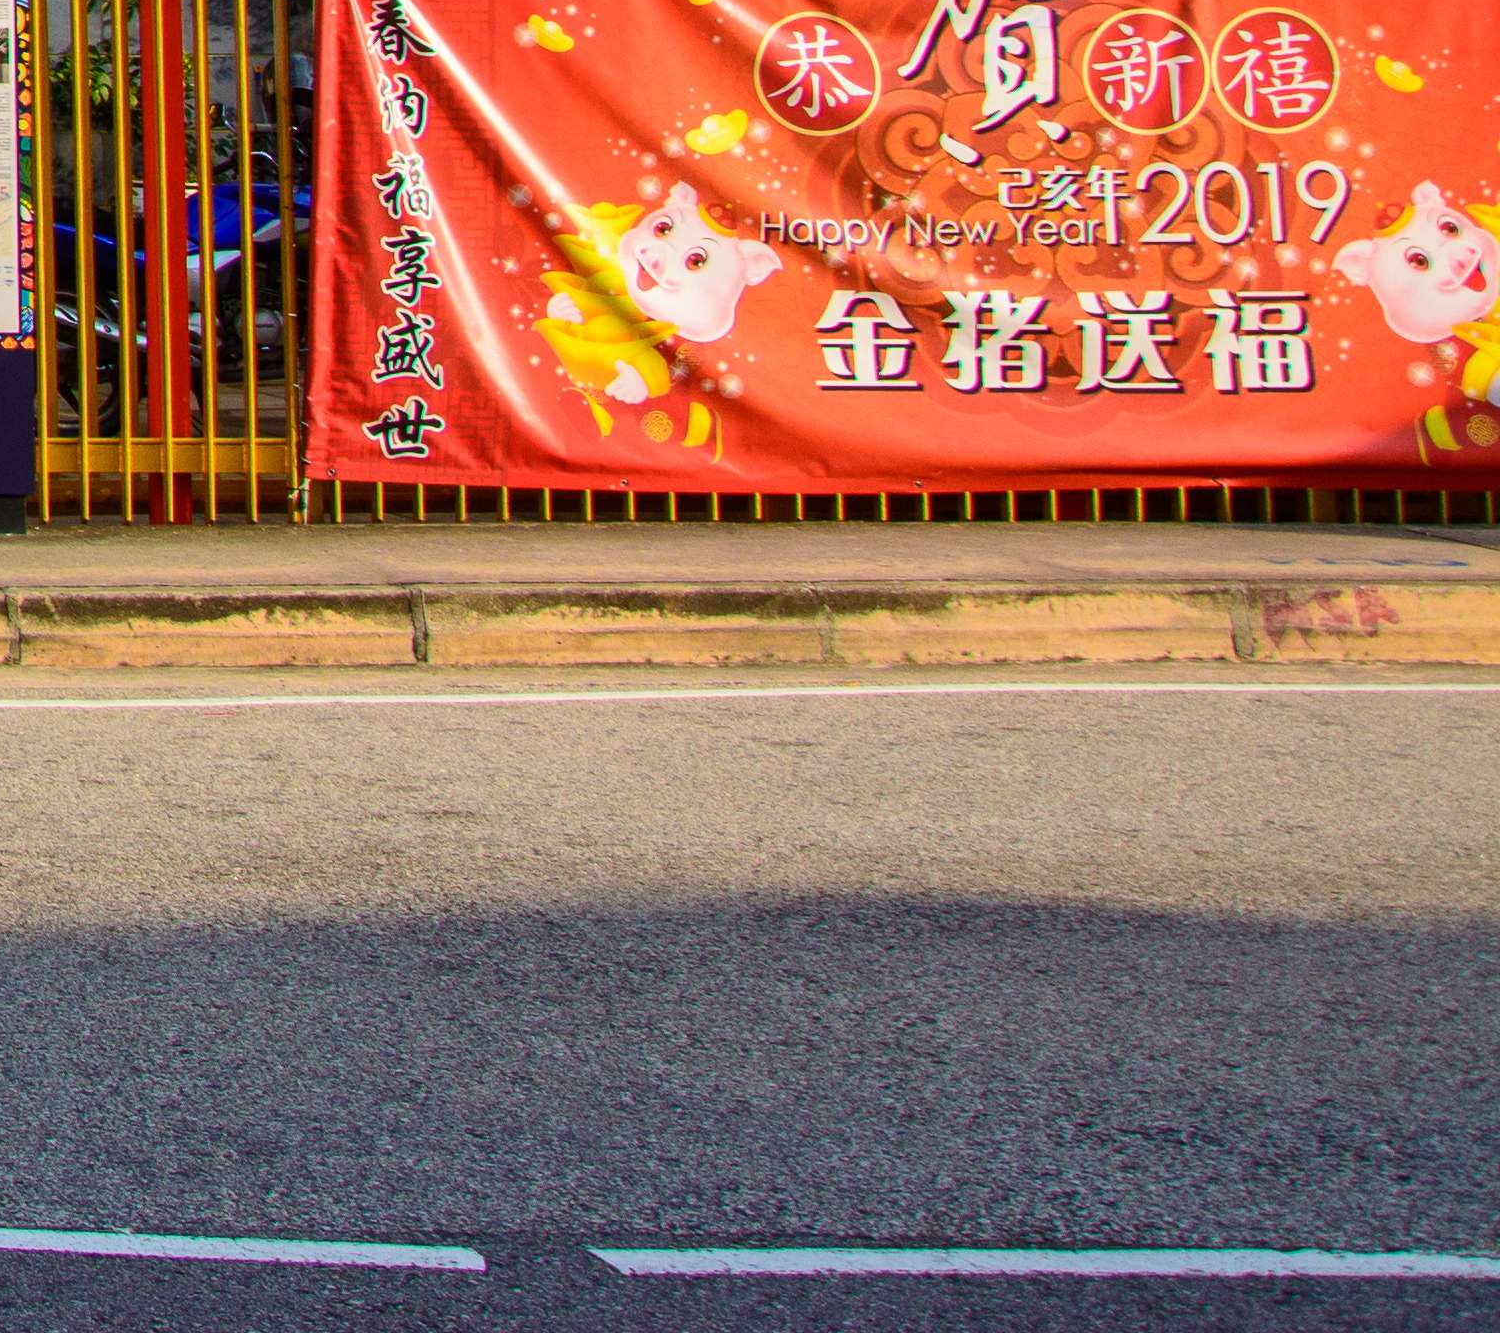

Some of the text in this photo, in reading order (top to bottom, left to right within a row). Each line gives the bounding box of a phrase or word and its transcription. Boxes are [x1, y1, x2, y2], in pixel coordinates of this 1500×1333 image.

[759, 211, 1100, 253] Happy New Year
[996, 160, 1351, 247] 己亥年 2019
[815, 287, 1318, 392] 金猪送福
